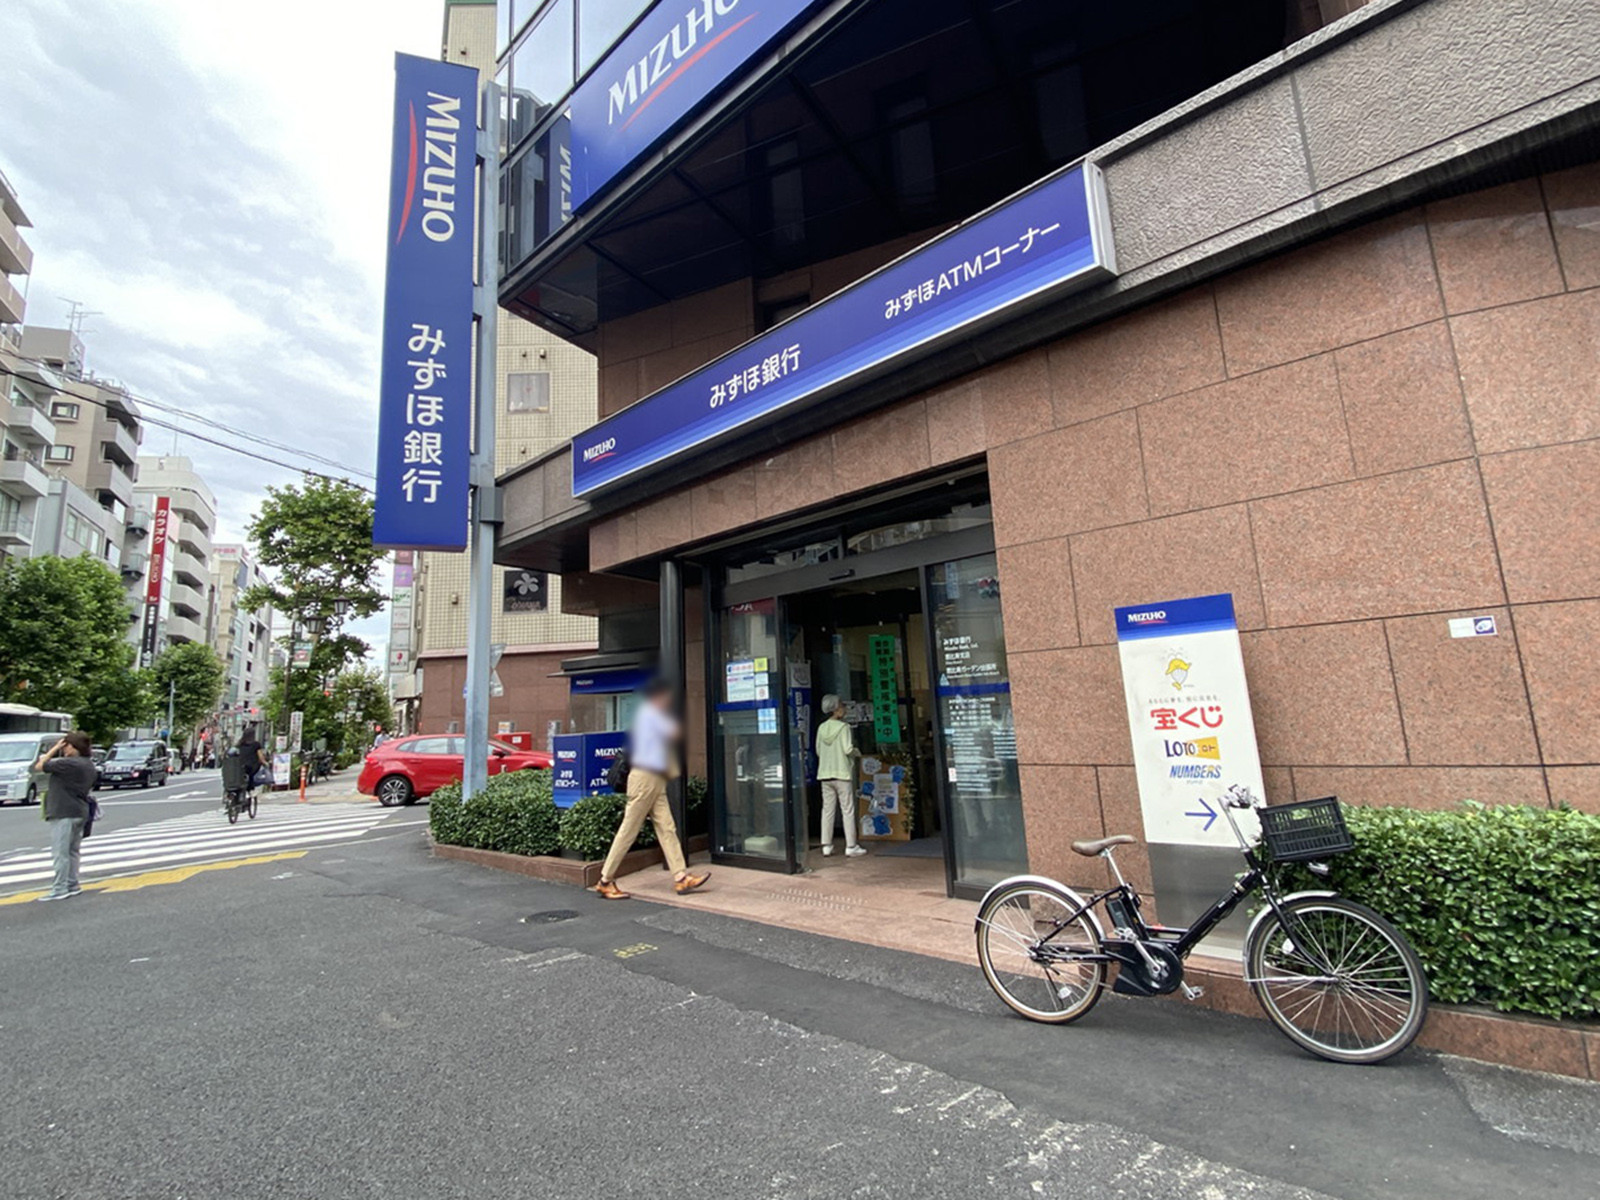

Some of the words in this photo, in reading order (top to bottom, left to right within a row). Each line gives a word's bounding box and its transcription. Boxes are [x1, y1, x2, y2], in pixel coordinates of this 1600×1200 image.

[422, 91, 461, 242] MIZUHO
[884, 222, 1060, 320] みずほATMコーナー
[709, 343, 801, 408] みずほ銀行
[402, 323, 447, 503] みずほ銀行
[583, 437, 616, 462] MIZUHO
[155, 508, 168, 545] カラオケ
[1127, 610, 1167, 623] MIZUHO
[1150, 706, 1224, 730] 宝くじ
[1164, 739, 1196, 758] LOTO
[1169, 765, 1222, 779] NUMBERS
